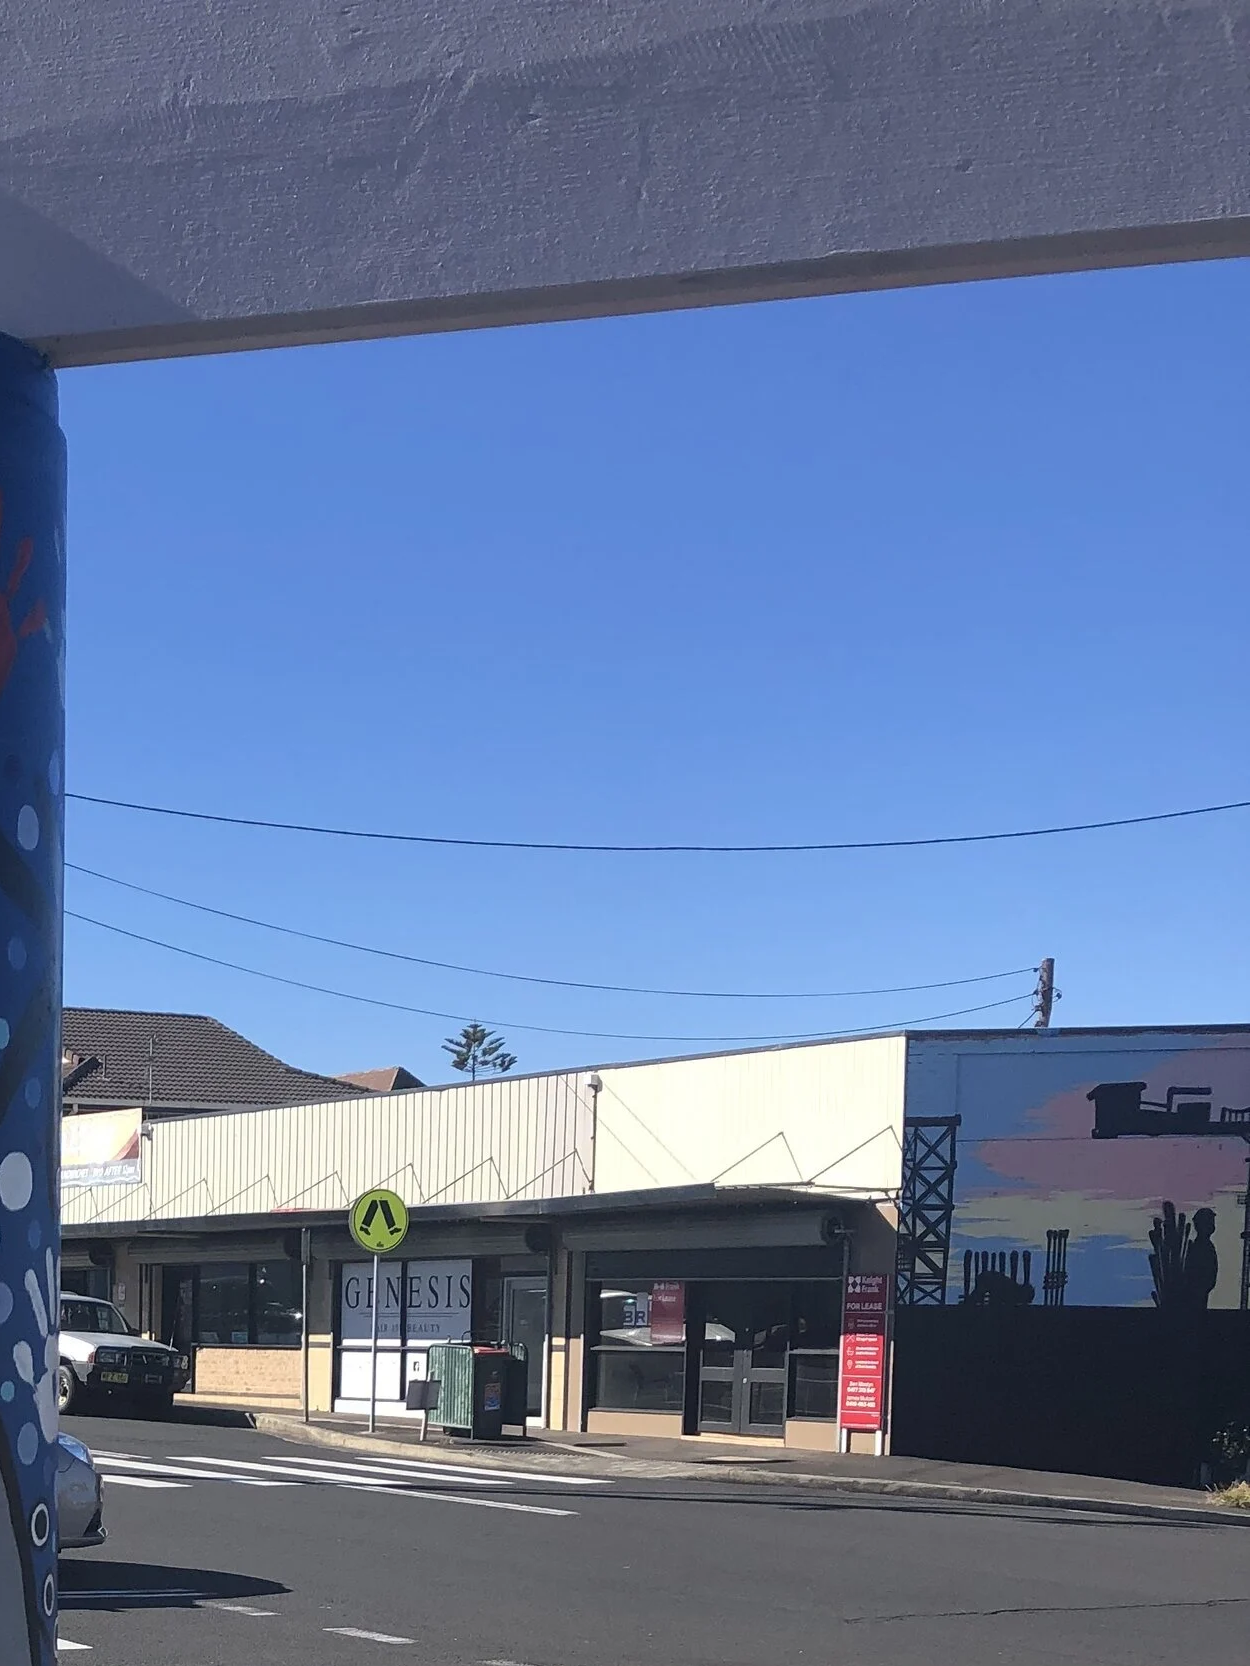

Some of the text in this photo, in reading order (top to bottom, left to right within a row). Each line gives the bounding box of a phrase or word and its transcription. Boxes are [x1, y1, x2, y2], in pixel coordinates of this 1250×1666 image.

[344, 1274, 471, 1310] GENESIS
[846, 1302, 883, 1310] FOR LEASE
[406, 1323, 441, 1333] BEAUTY
